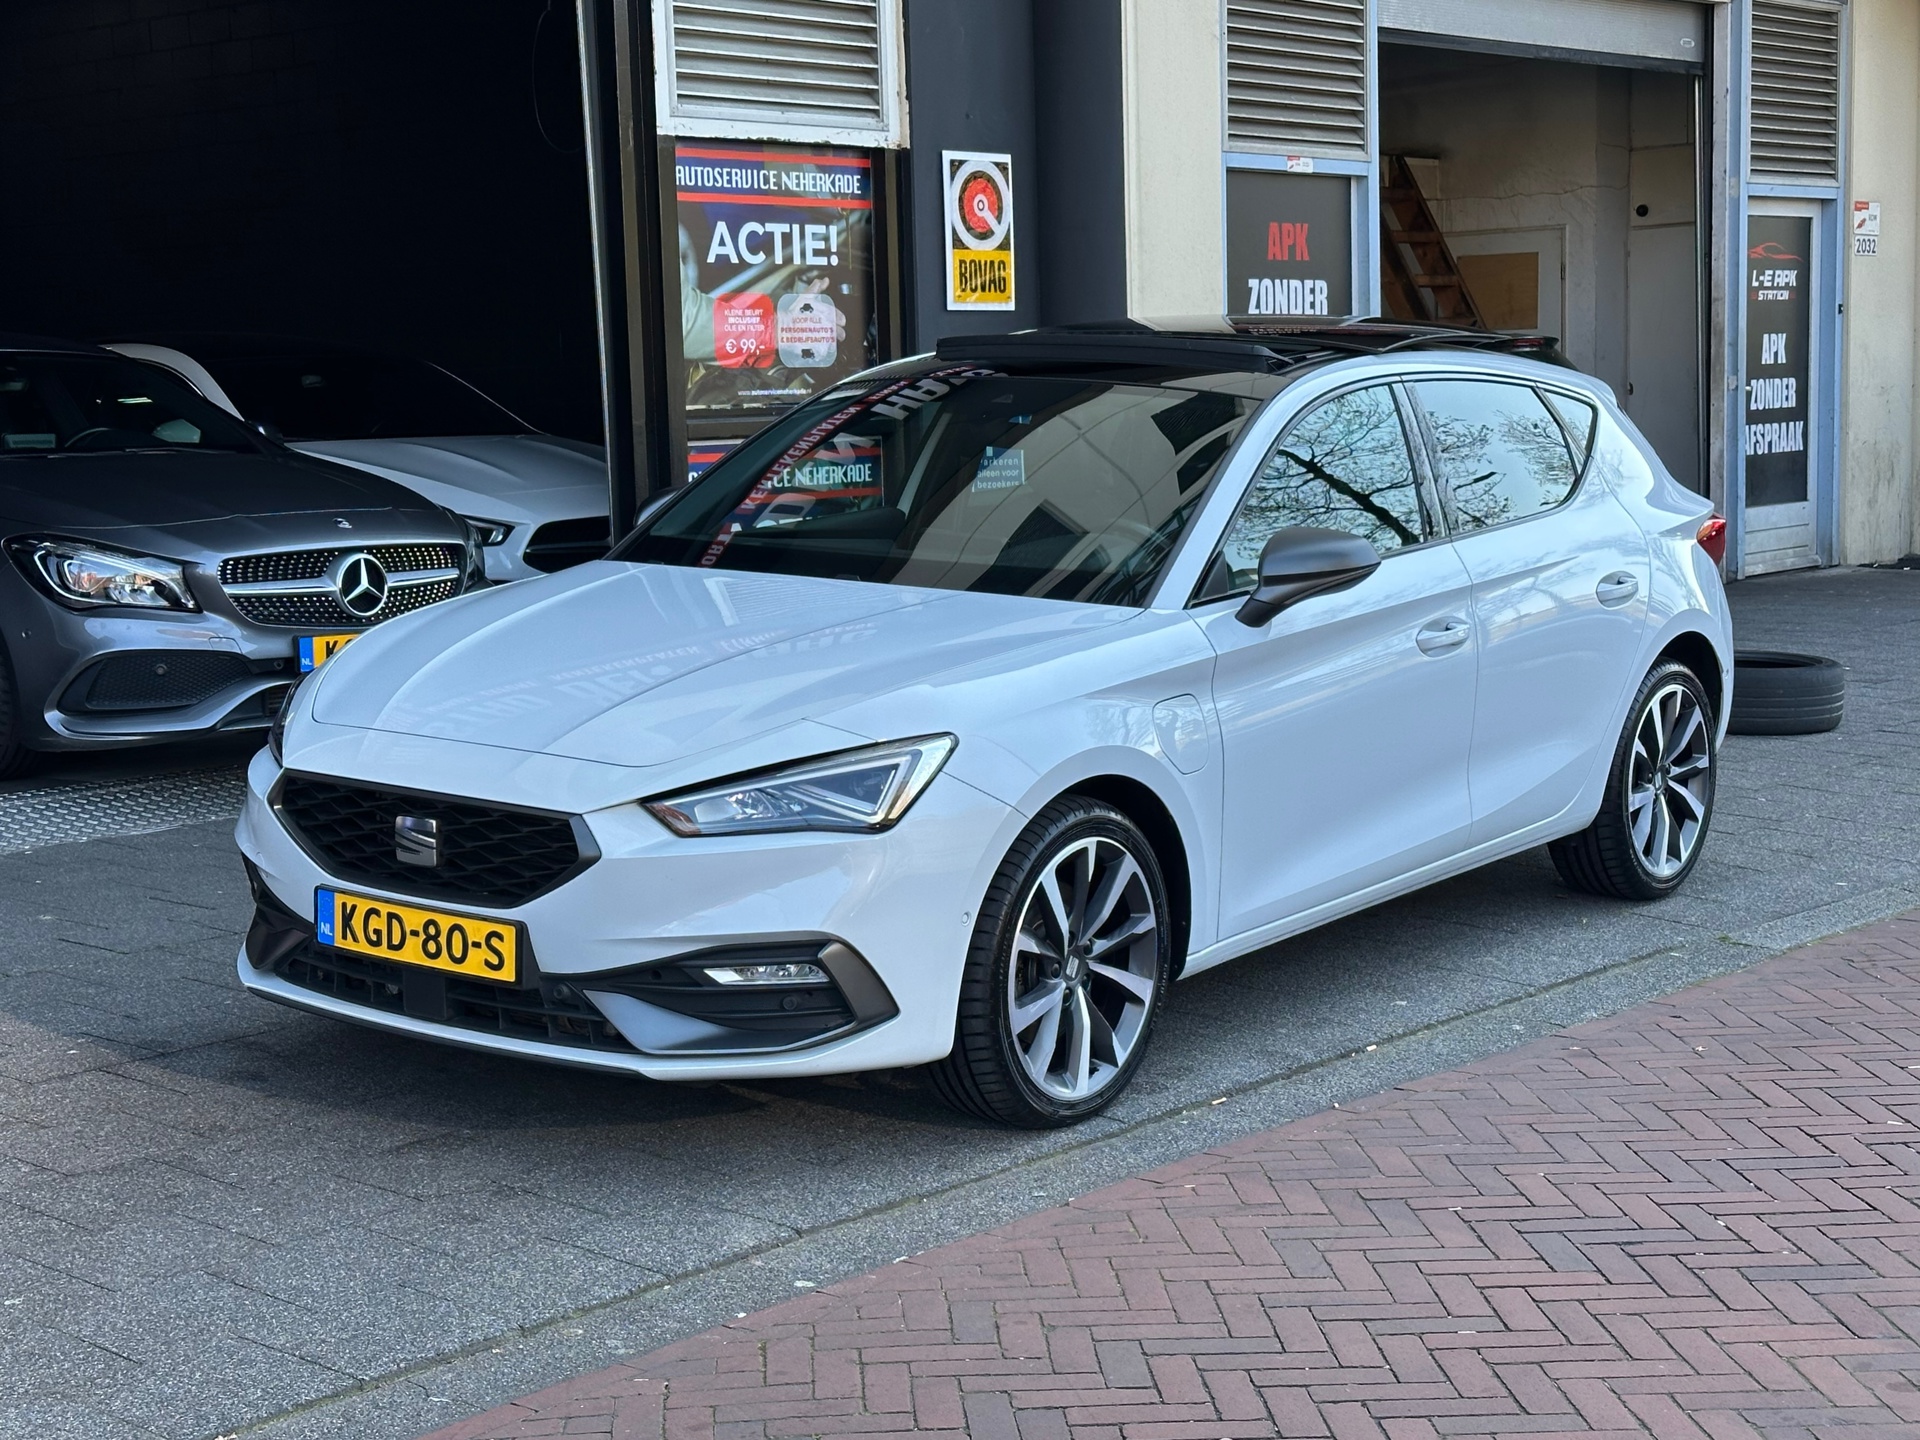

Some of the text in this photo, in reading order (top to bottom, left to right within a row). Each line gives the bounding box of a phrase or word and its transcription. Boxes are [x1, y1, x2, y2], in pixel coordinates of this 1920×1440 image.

[675, 165, 863, 194] AUTOSERVICE NEHERKADE
[706, 220, 840, 267] ACTIE!
[1267, 221, 1311, 261] APK
[1856, 238, 1877, 254] 2032
[958, 258, 1008, 294] BOVAG
[1751, 269, 1798, 287] L-E APK
[1247, 278, 1329, 316] ZONDER
[1757, 289, 1790, 301] STATION
[724, 308, 764, 316] KLEINE BEURT
[728, 316, 761, 324] INCLUSIEF
[724, 324, 766, 332] OLIE EN FILTER
[1761, 333, 1787, 365] APK
[1750, 377, 1797, 411] ZONDER
[980, 458, 1019, 467] arkeren
[794, 463, 873, 486] NEHERKADE
[1001, 469, 1020, 477] voor
[301, 657, 313, 666] NL
[320, 921, 333, 936] NL
[340, 901, 506, 972] KGD-80-S
